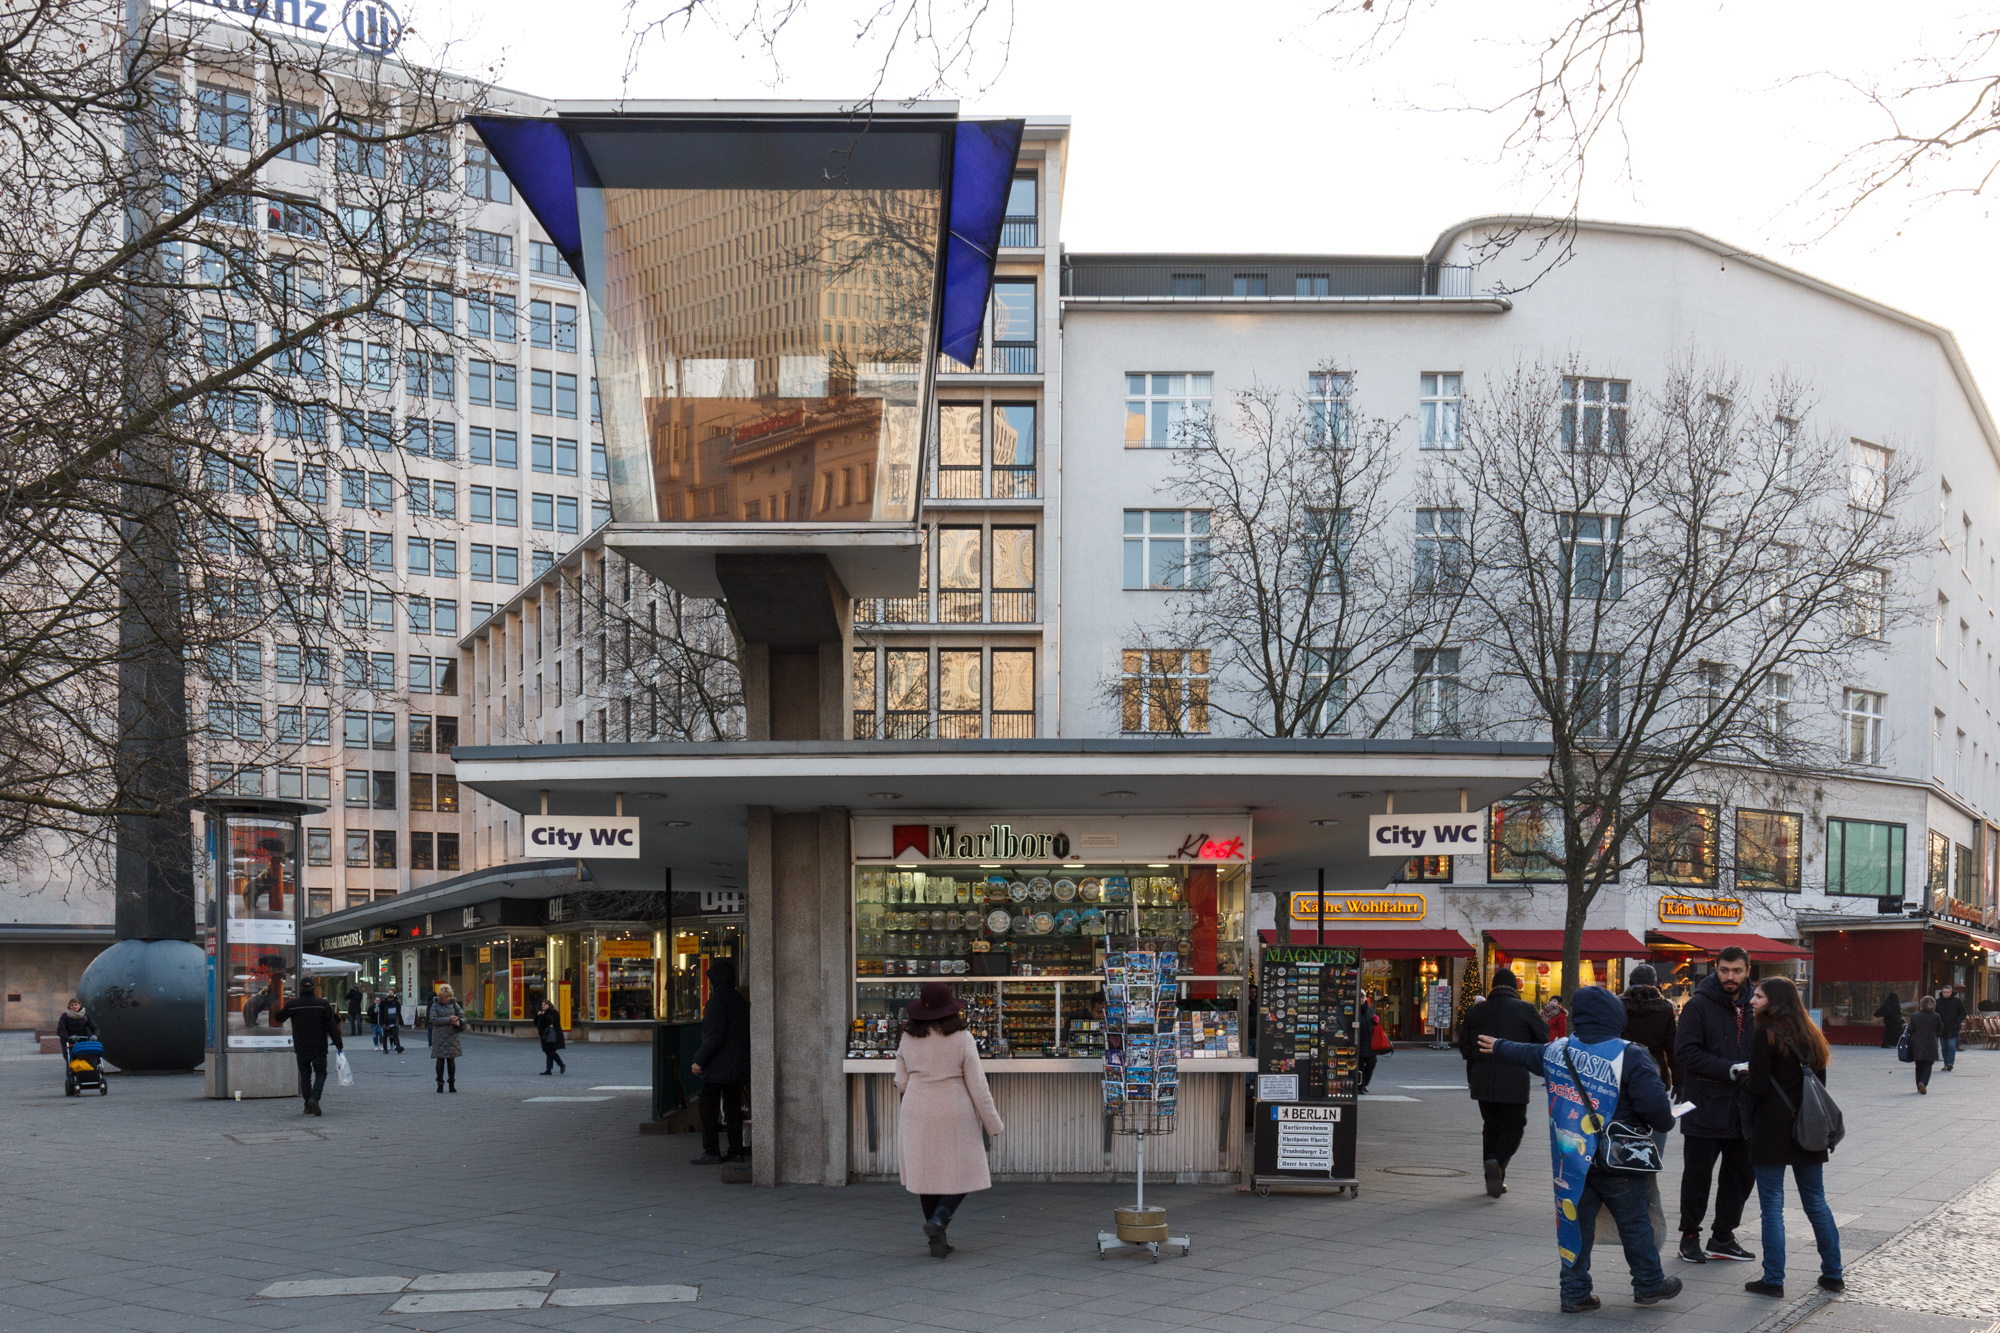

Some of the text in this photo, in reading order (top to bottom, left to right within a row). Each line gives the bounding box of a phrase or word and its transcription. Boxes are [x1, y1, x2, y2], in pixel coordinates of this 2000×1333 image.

[531, 826, 633, 851] City WC
[931, 824, 1070, 860] Marlboro
[1376, 824, 1477, 849] City WC
[247, 846, 268, 856] Feb
[247, 856, 273, 865] 2017
[1299, 900, 1418, 913] Kähe Wohlfahrt
[1696, 903, 1740, 918] Wohlfahrt
[385, 927, 398, 936] sky
[231, 944, 279, 955] Berlinale
[1265, 948, 1356, 964] MAGNETS
[247, 963, 269, 973] Feb
[247, 972, 273, 981] 2017
[1598, 1086, 1617, 1098] Berlin
[1292, 1108, 1337, 1120] BERLIN
[1567, 1108, 1579, 1120] je
[1282, 1148, 1318, 1156] Brandenburger
